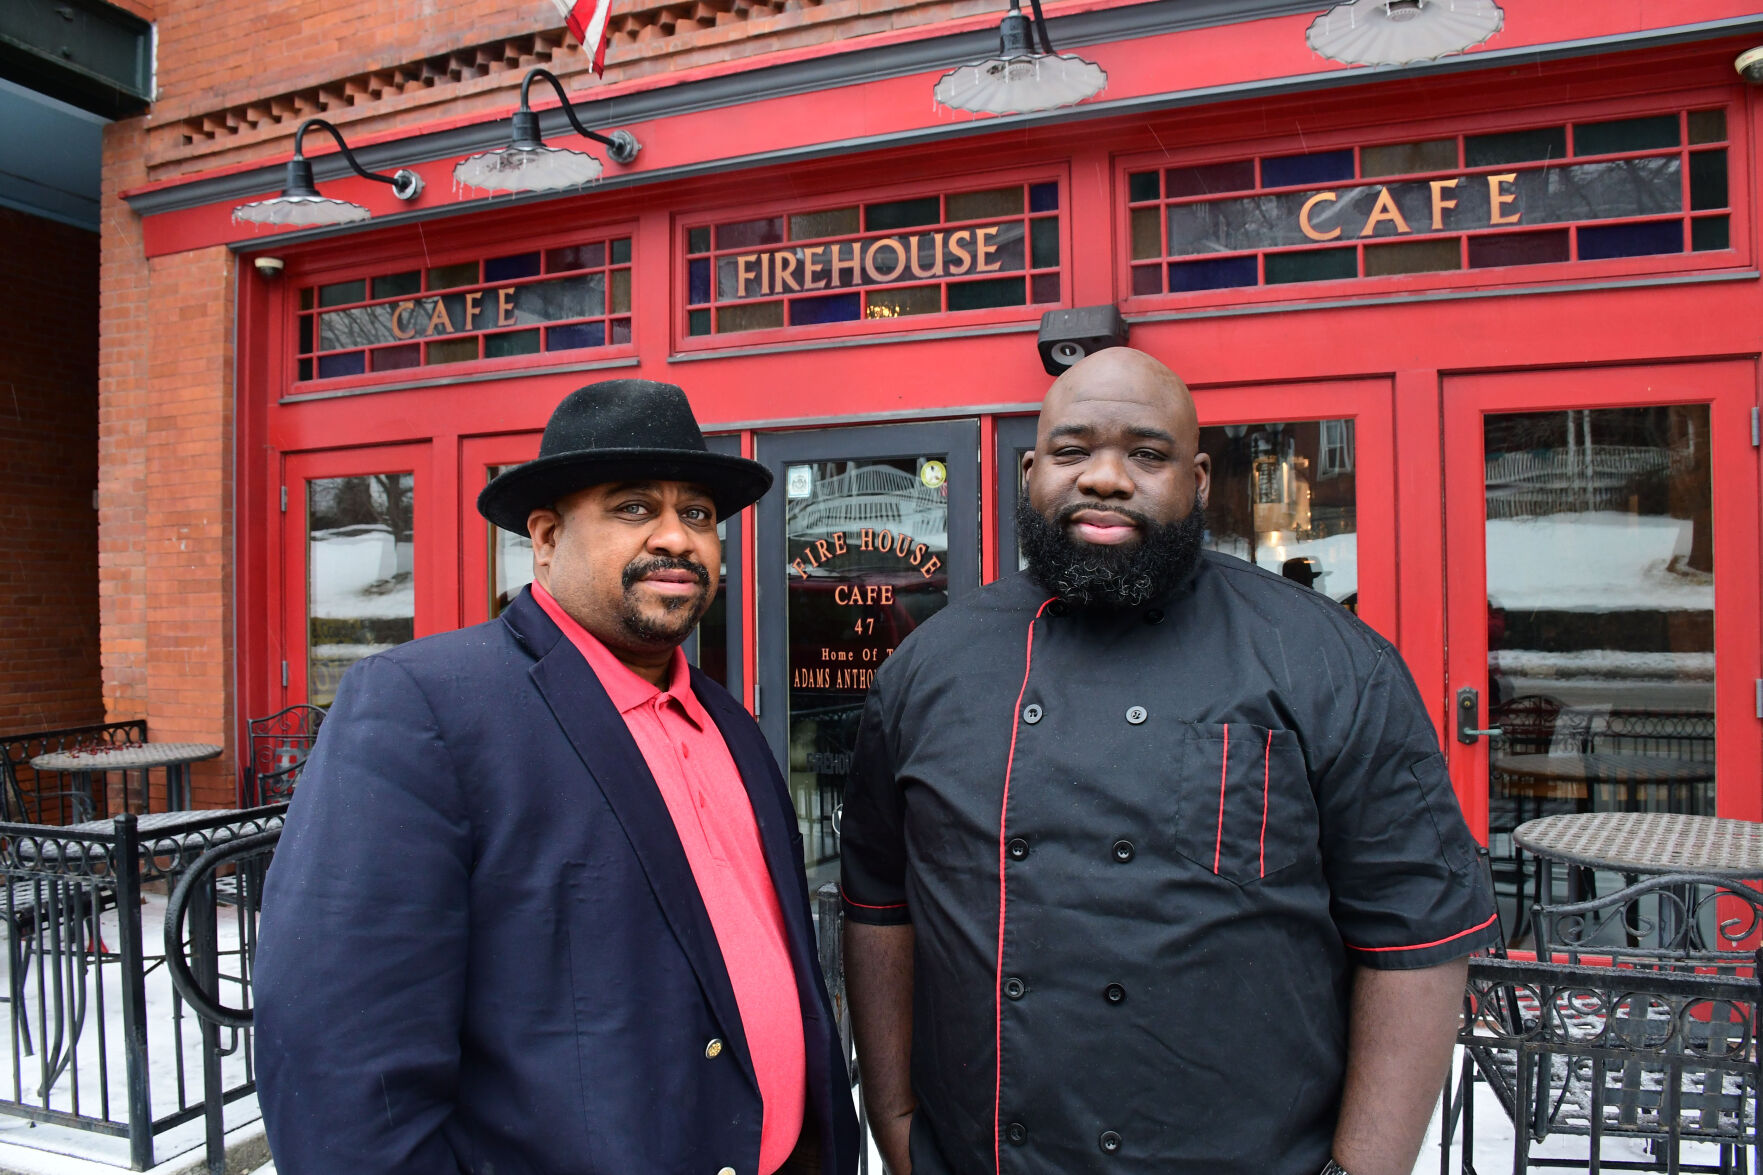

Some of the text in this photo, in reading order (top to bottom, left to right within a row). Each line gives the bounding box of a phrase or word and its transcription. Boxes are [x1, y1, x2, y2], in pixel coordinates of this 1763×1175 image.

[1299, 172, 1522, 241] CAFE
[736, 226, 1003, 299] FIREHOUSE
[391, 287, 518, 339] CAFE
[792, 528, 942, 580] FIRE HOUSE
[834, 585, 894, 606] CAFE
[854, 618, 875, 636] 47
[821, 648, 854, 661] Home
[862, 648, 878, 661] Of
[794, 668, 877, 688] ADAMS ANTHO
